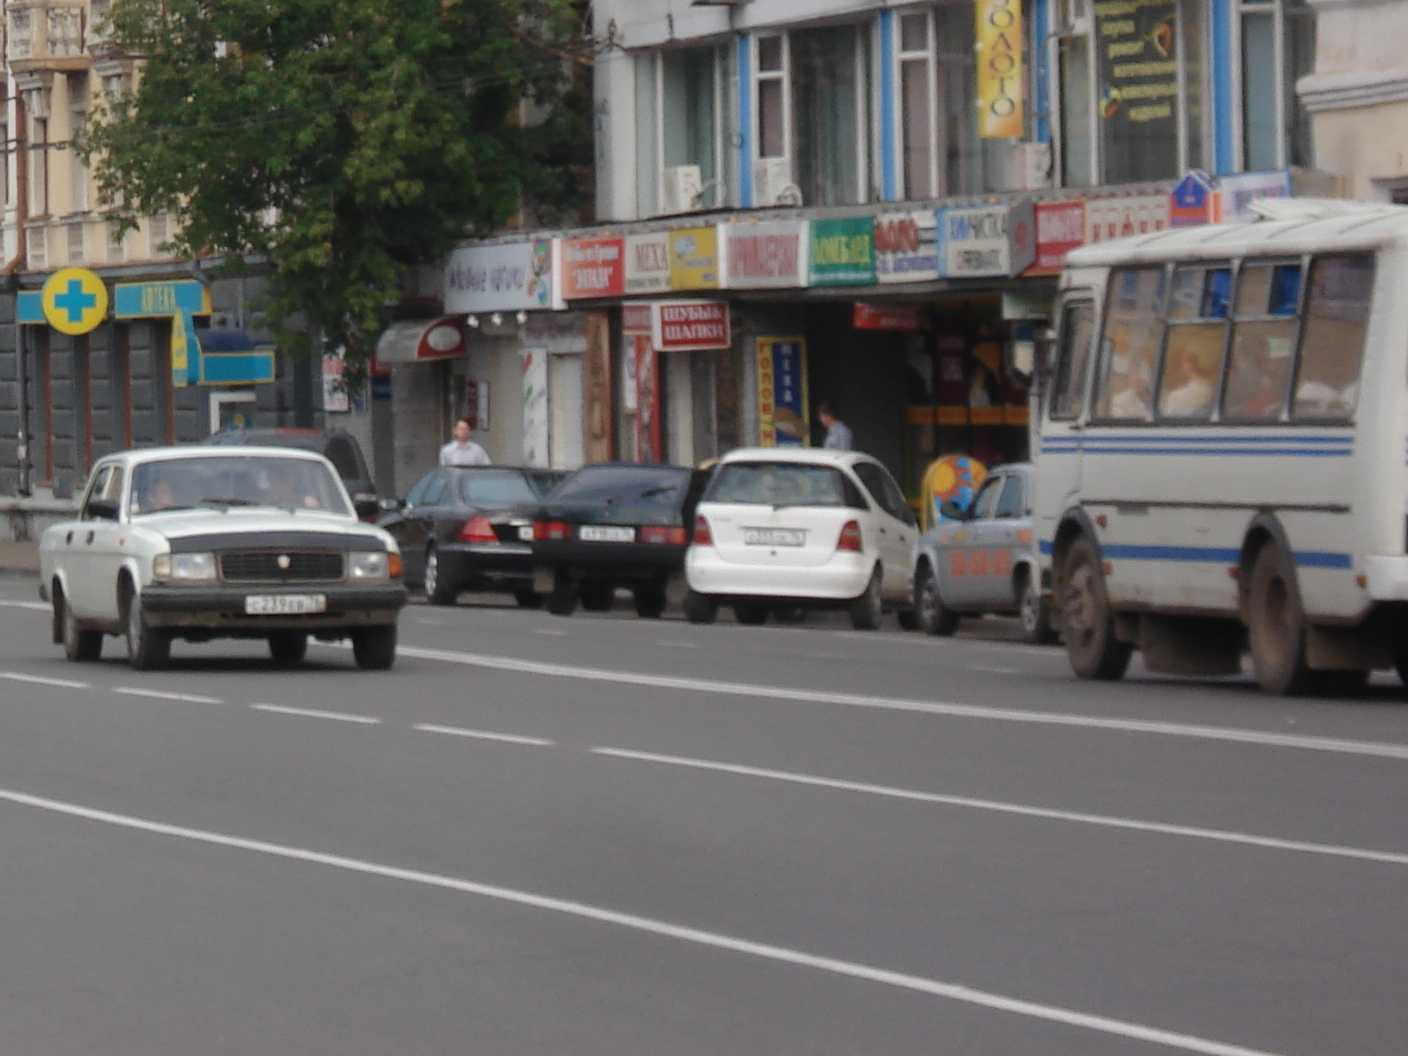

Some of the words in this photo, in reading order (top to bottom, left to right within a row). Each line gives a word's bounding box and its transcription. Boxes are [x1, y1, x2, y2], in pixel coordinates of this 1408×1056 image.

[635, 243, 669, 272] МЕХА
[142, 286, 176, 311] АПТЕКА
[663, 305, 712, 322] ШУБЫ
[664, 323, 724, 341] ШАПКИ
